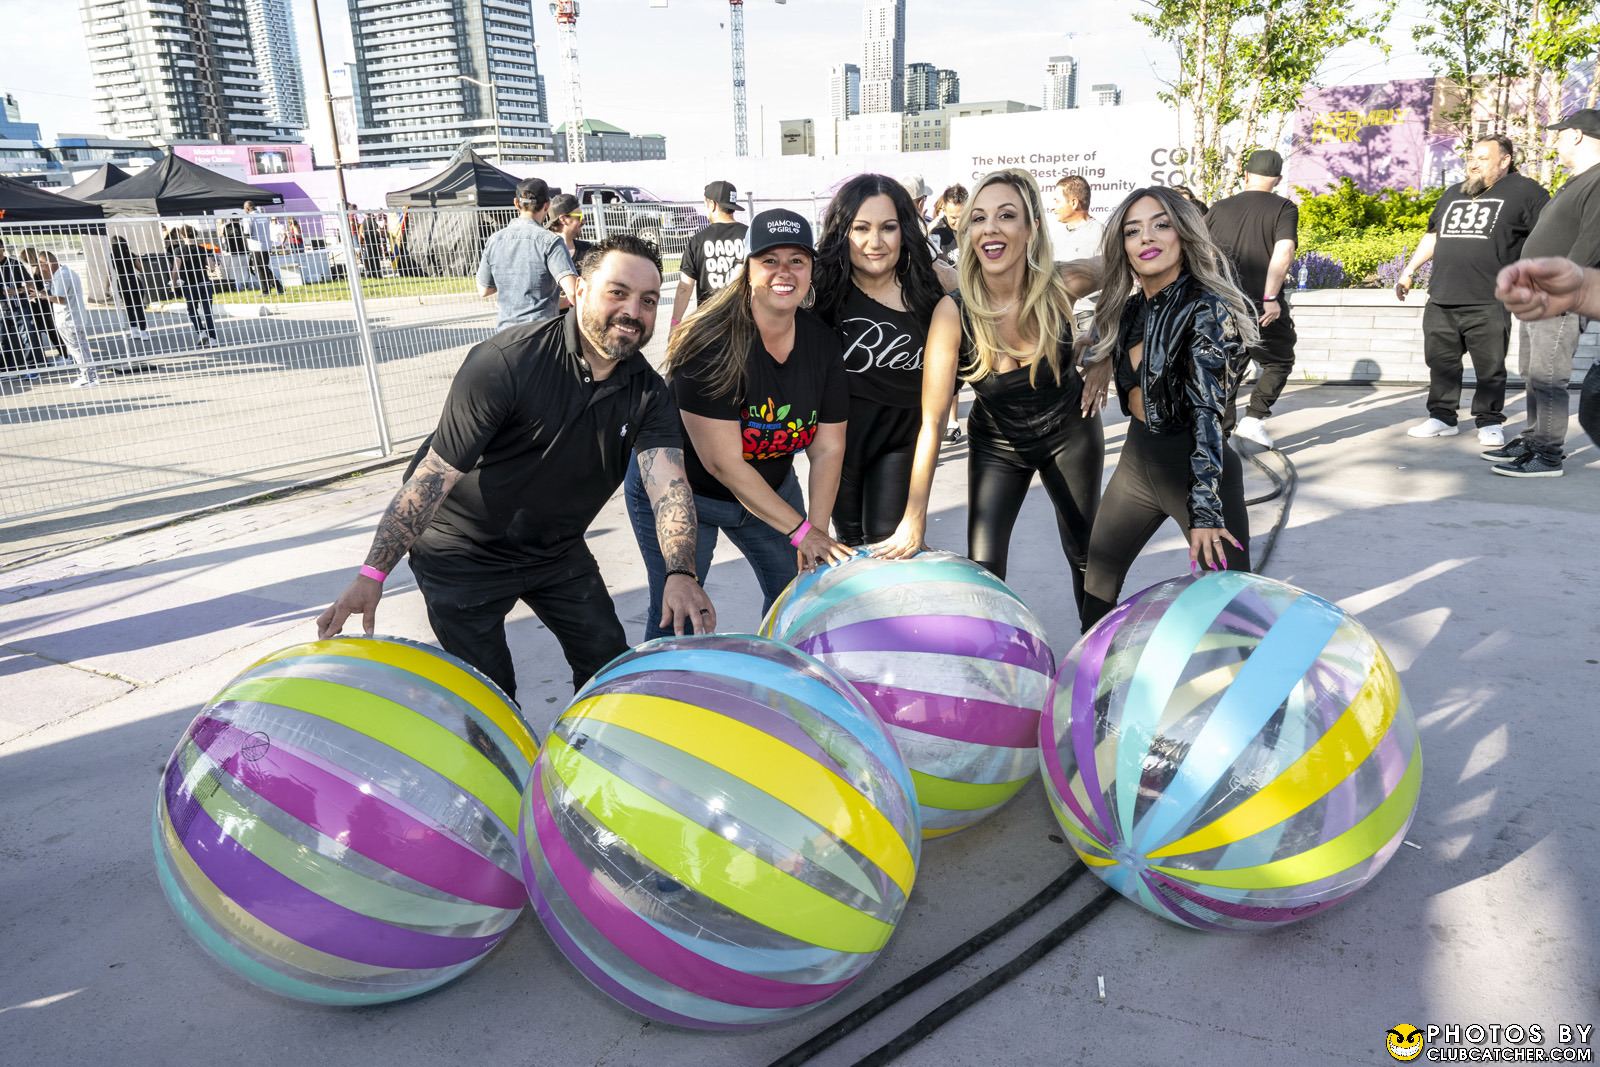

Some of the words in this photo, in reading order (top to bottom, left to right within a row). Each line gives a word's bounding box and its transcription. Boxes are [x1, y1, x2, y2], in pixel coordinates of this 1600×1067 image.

[1311, 107, 1411, 128] ASSEMBLY
[1311, 126, 1361, 144] PARK
[972, 155, 994, 166] The
[997, 154, 1026, 165] Next
[1029, 152, 1080, 164] Chapter
[1083, 150, 1097, 161] of
[1029, 165, 1106, 178] Best-Selling
[1090, 179, 1136, 193] munity
[767, 220, 801, 229] DIAMOND
[1447, 203, 1491, 230] 333
[777, 226, 794, 234] GIRL
[703, 238, 745, 260] DADD
[705, 256, 736, 274] DAY
[842, 317, 925, 374] Bles
